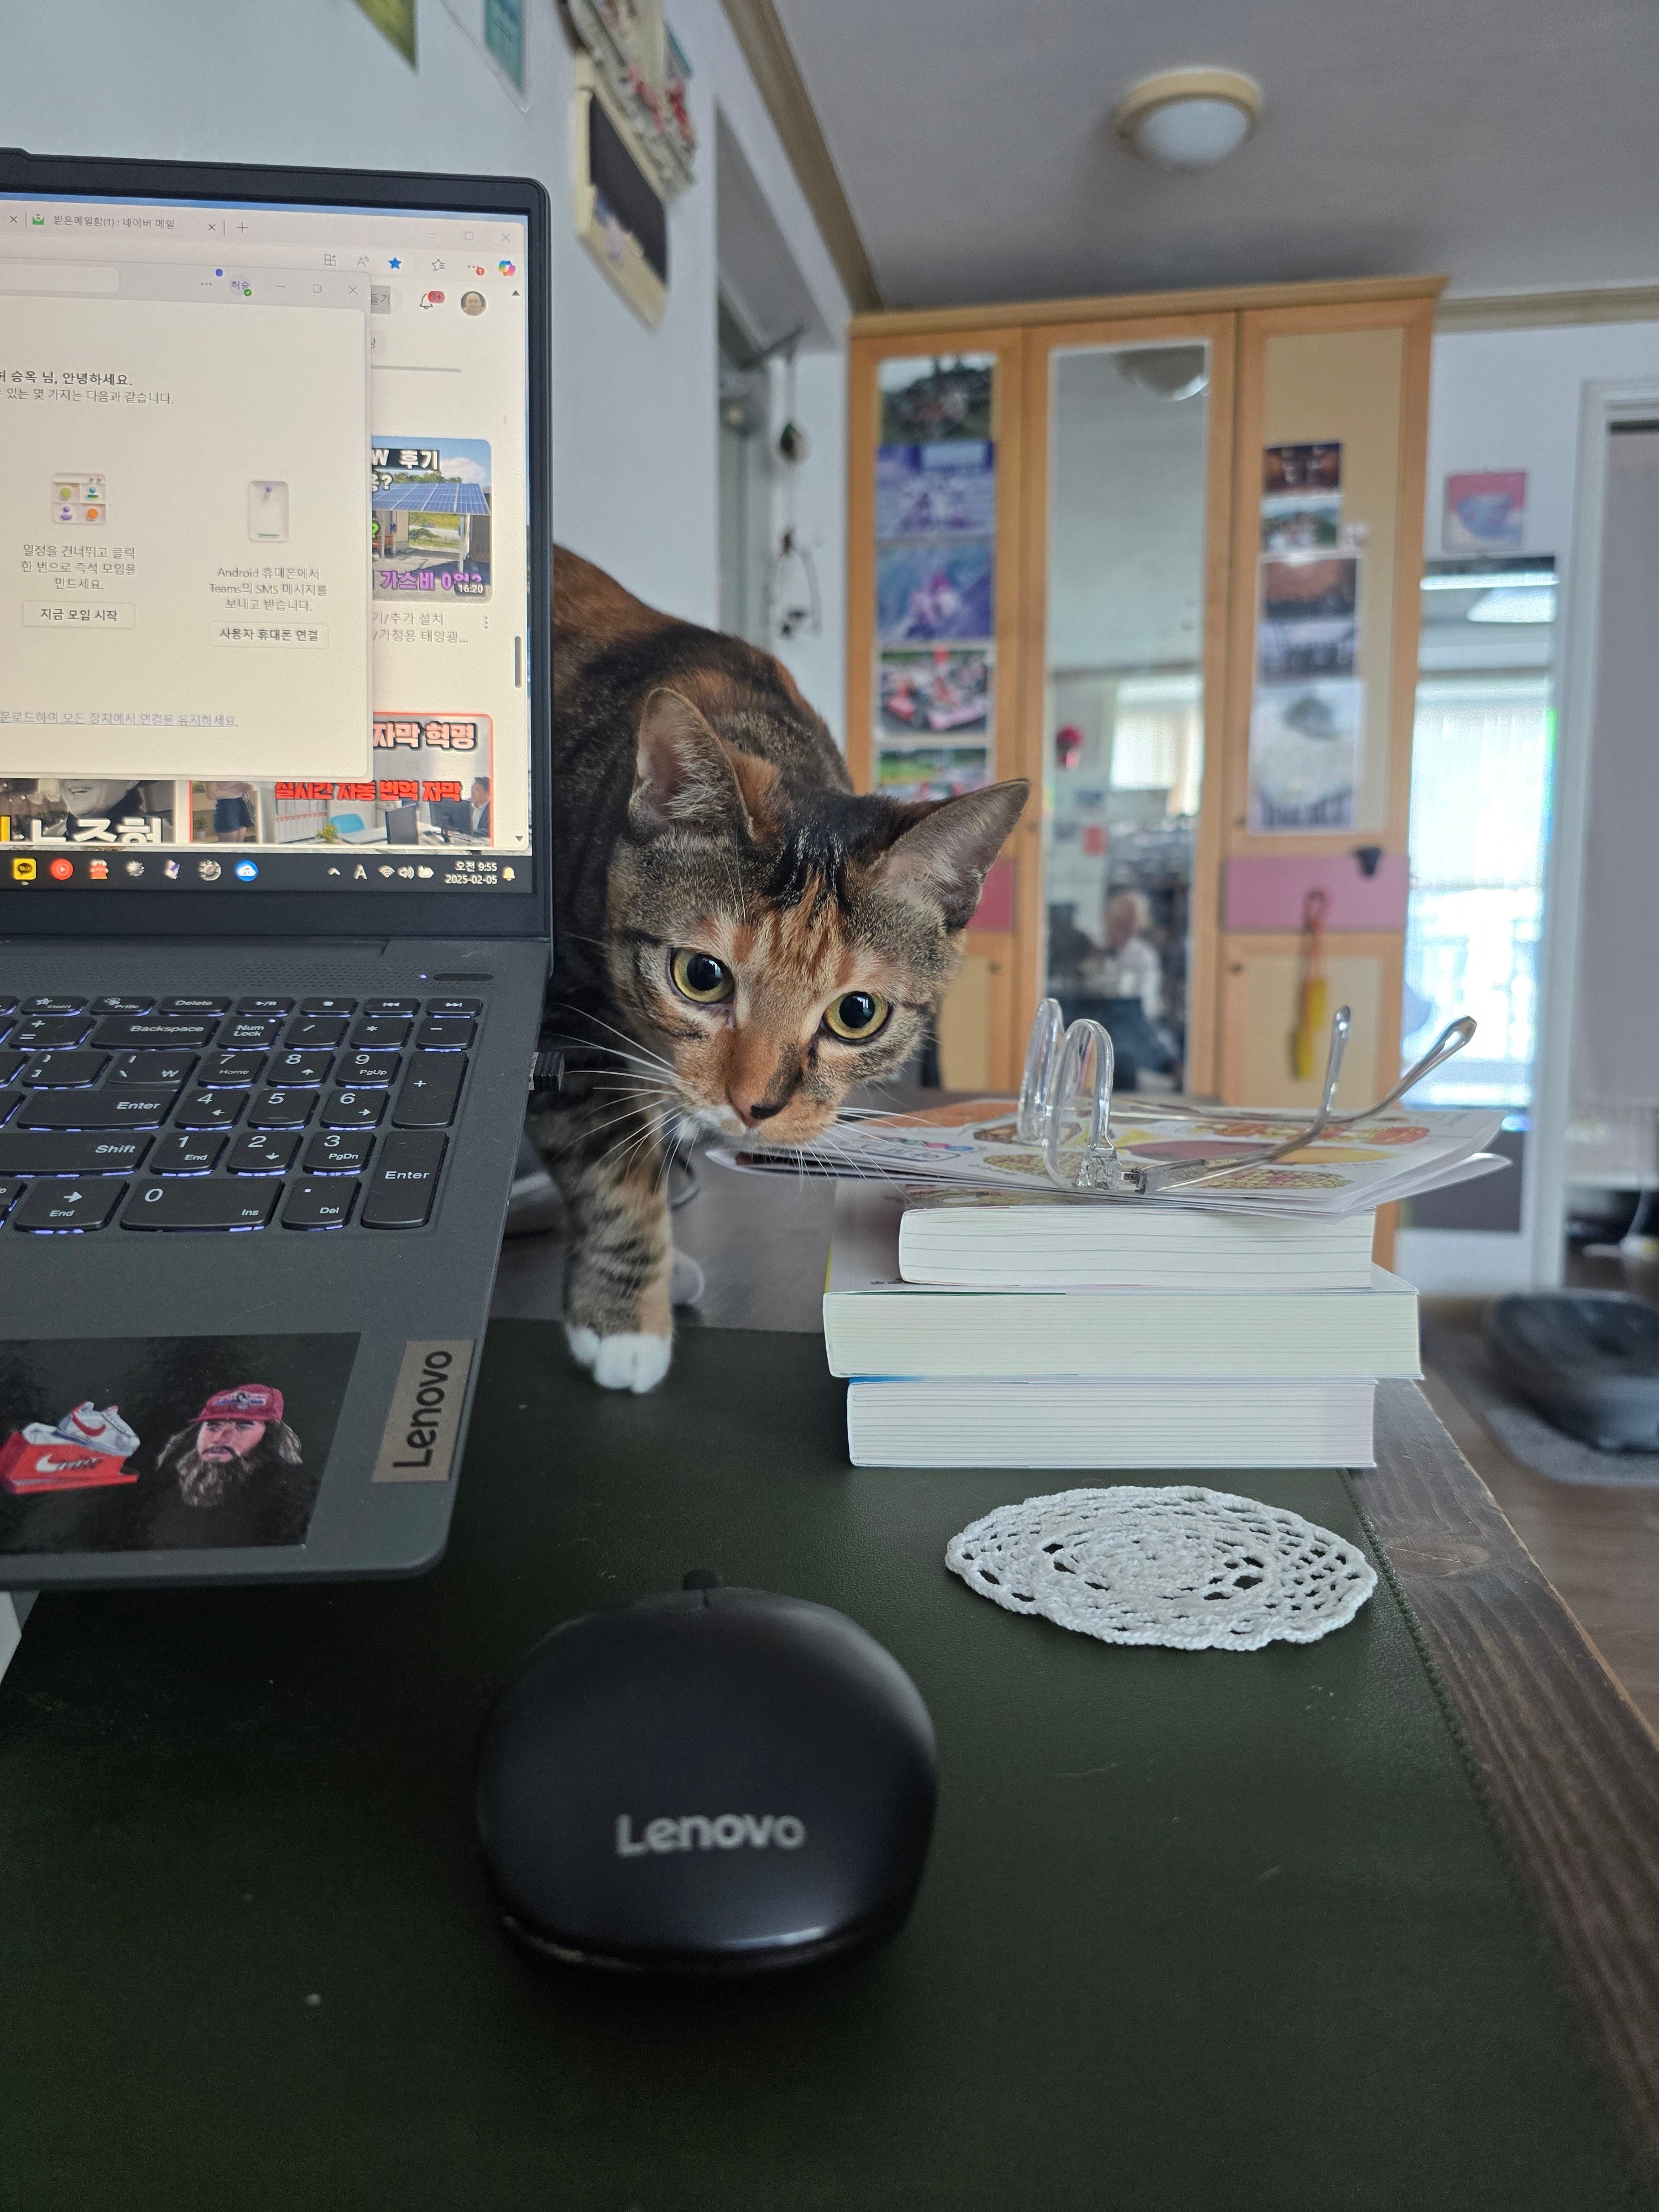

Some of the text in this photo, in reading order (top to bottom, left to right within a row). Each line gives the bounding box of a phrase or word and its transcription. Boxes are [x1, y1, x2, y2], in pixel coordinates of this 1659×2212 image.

[54, 216, 114, 227] 받은메일함(1)
[123, 218, 152, 228] 네이버
[155, 220, 175, 229] 메일
[431, 293, 442, 301] 9+
[11, 370, 37, 383] 승옥
[42, 372, 58, 385] 님,
[62, 372, 133, 386] 안녕하세요.
[7, 388, 174, 404] 있는 몇 가지는 다음과 같습니다.
[400, 450, 438, 470] 후기
[23, 544, 135, 559] 일정을 건너뛰고 클릭
[21, 560, 137, 575] 한 번으로 즉석 모임을
[217, 567, 320, 580] Android 휴대폰에서
[55, 578, 105, 590] 만드세요.
[380, 571, 435, 590] 가스비
[209, 583, 328, 596] Teams의 SMS 메시지를
[457, 584, 484, 593] 16:20
[226, 598, 312, 612] 보내고 받습니다.
[41, 608, 118, 622] 지금 모임 시작
[420, 613, 444, 625] 설치
[220, 628, 319, 642] 사용자 휴대폰 연결
[63, 713, 86, 724] 모든
[90, 713, 135, 724] 장치에서
[140, 713, 174, 726] 연결을
[178, 714, 239, 726] 유지하세요.
[425, 721, 474, 749] 혁명
[337, 780, 376, 801] 자동
[379, 780, 419, 801] 번역
[422, 780, 461, 802] 자막
[455, 860, 498, 872] 오전 9:55
[444, 874, 498, 884] 2025-02-05
[130, 1025, 205, 1033] Backspace
[221, 1054, 236, 1064] 7
[284, 1054, 302, 1065] 8
[354, 1054, 371, 1065] 9
[197, 1093, 213, 1104] 4
[268, 1093, 286, 1104] 5
[339, 1093, 356, 1104] 6
[116, 1102, 161, 1110] Enter
[179, 1136, 189, 1148] 1
[247, 1136, 267, 1147] 2
[324, 1135, 341, 1147] 3
[95, 1145, 136, 1154] Shift
[328, 1153, 359, 1161] PgDn
[385, 1171, 430, 1179] Enter
[392, 1350, 453, 1469] Lenovo
[615, 1814, 806, 1858] Lenovo
